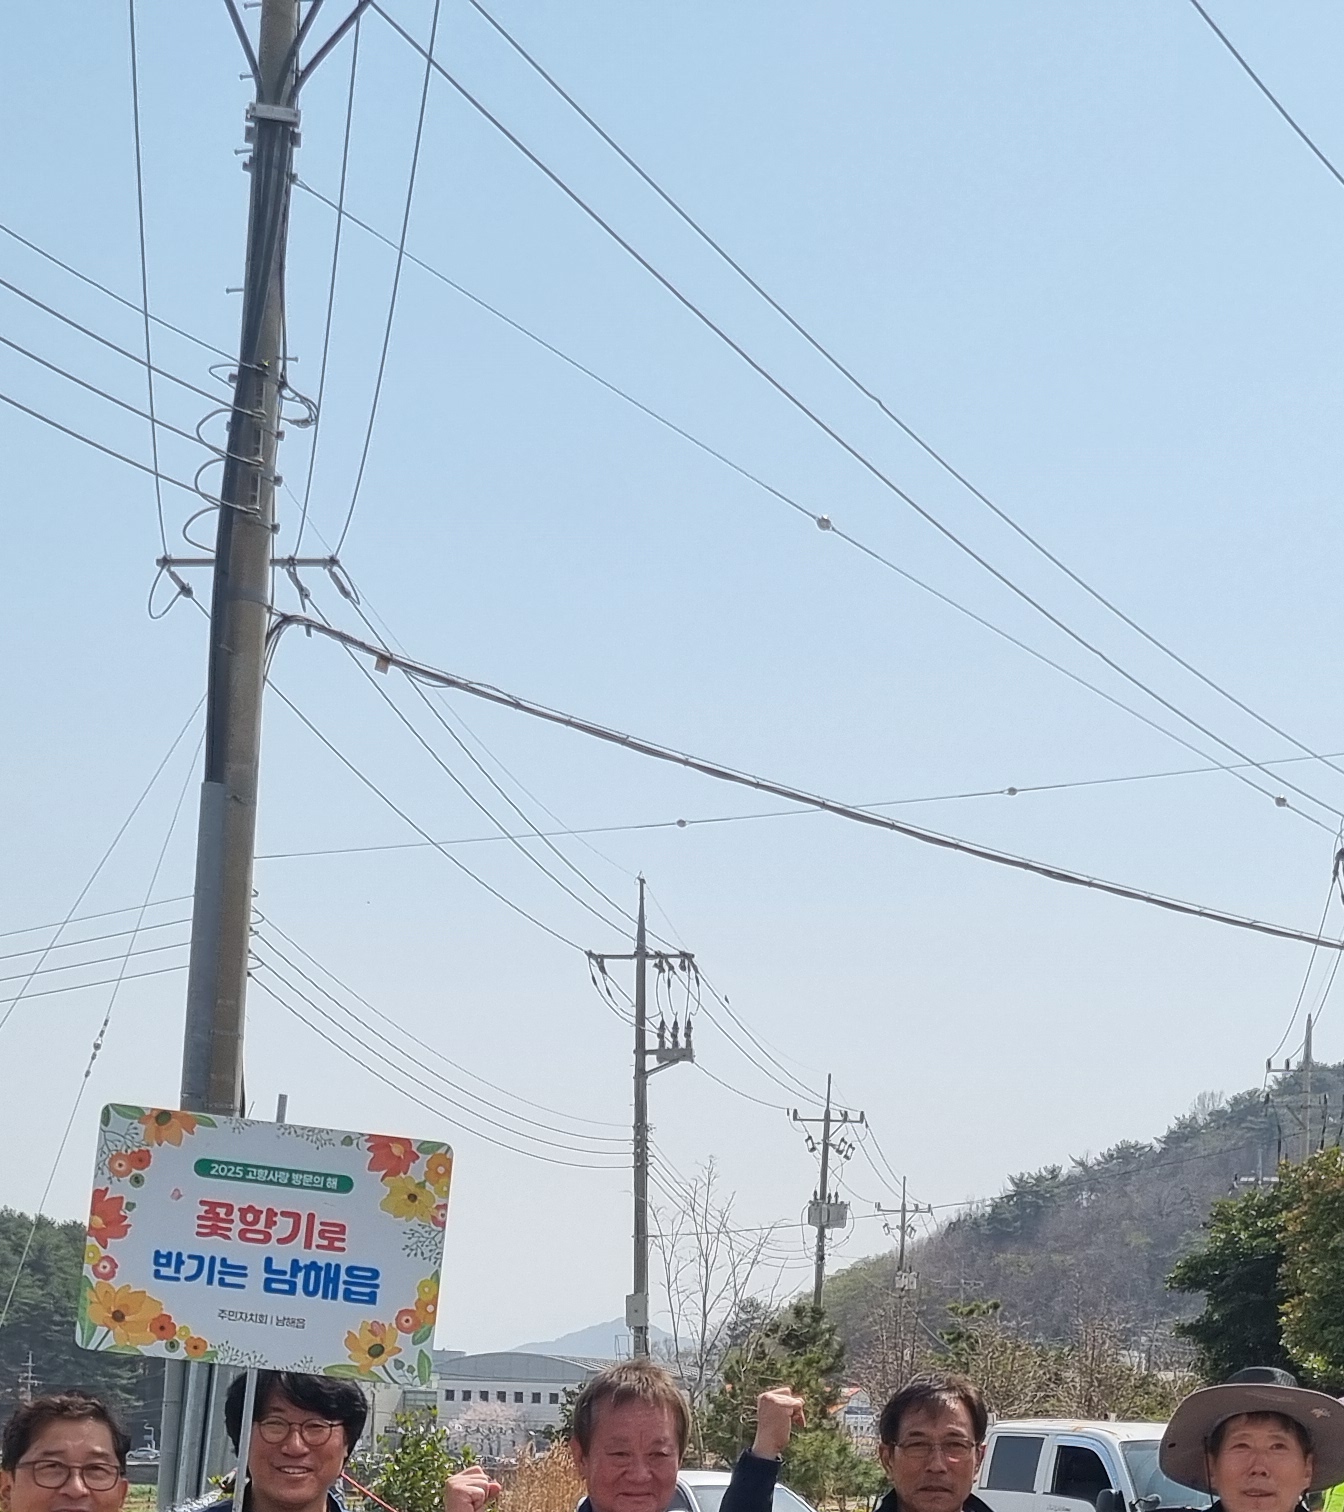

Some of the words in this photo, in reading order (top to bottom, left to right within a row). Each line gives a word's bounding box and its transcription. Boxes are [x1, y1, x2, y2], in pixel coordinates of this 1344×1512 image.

[209, 1162, 244, 1179] 2025
[245, 1166, 288, 1183] 고향사랑
[291, 1172, 324, 1188] 방문의
[325, 1176, 338, 1190] 해
[195, 1199, 348, 1252] 꽃향기로
[153, 1248, 248, 1289] 반기는
[262, 1256, 381, 1306] 남해읍
[217, 1309, 268, 1325] 주민자치회
[274, 1315, 306, 1330] 남해읍
